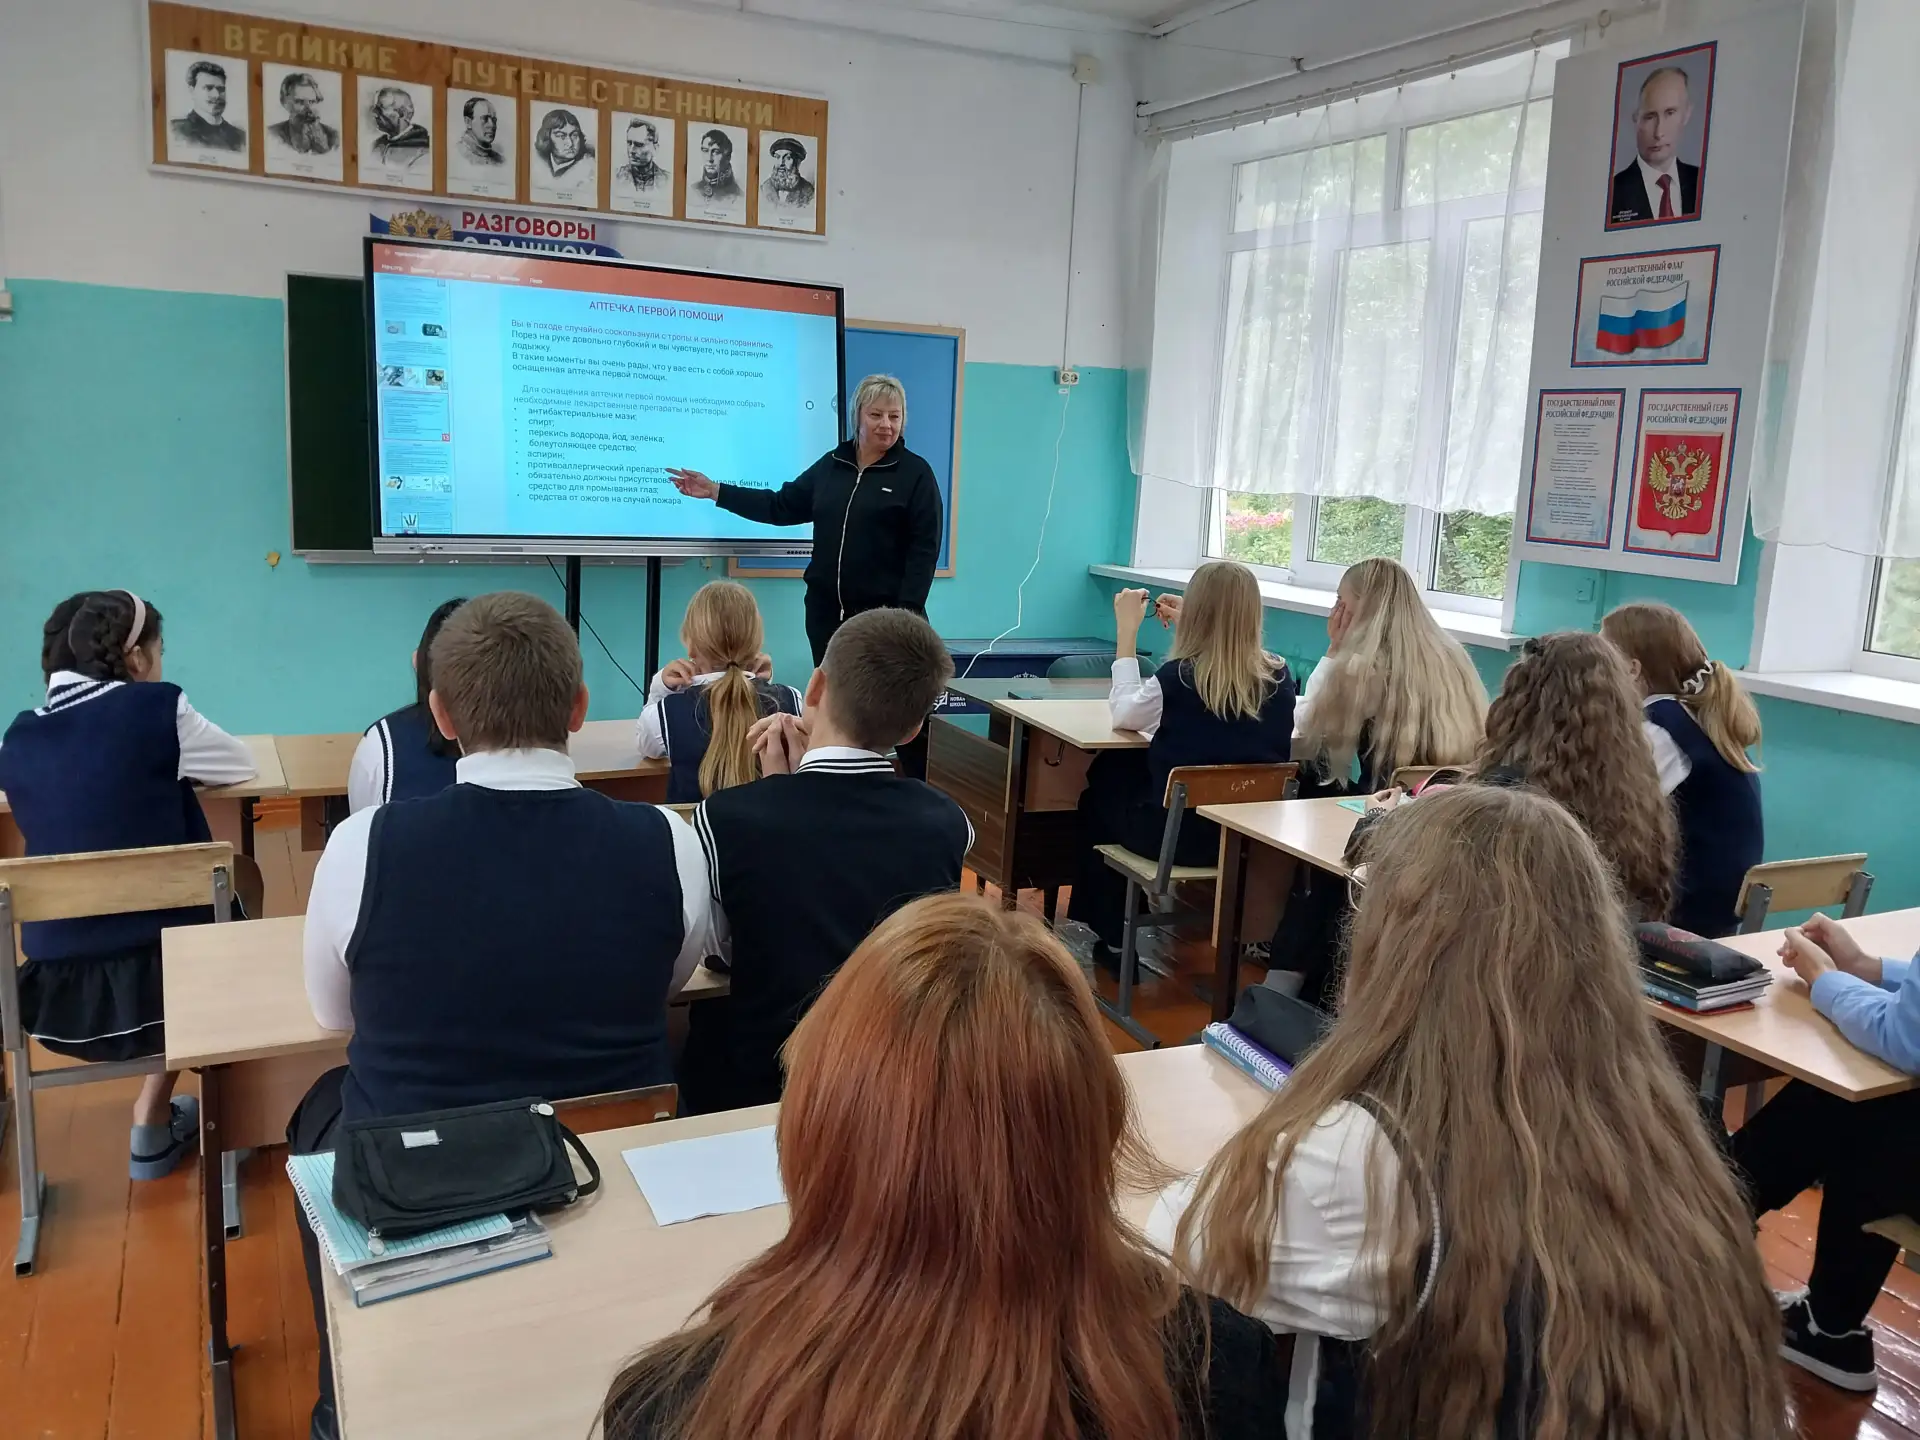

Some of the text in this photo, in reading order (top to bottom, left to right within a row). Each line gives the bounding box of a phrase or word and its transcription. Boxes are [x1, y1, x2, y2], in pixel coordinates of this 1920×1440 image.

[224, 24, 398, 74] ВЕЛИКИЕ
[452, 57, 773, 127] ПУТЕШЕСТВЕННИКИ
[462, 211, 596, 241] РАЗГОВОРЫ
[1608, 261, 1685, 275] ГОСУДАРСТВЕННЫЙ ФЛАГ
[1606, 273, 1684, 287] РОССИЙСКОЙ ФЕДЕРАЦИИ
[589, 301, 724, 322] АПТЕЧКА ПЕРВОЙ ПОМОЩИ
[511, 319, 524, 327] Вы
[533, 322, 563, 332] походе
[564, 324, 603, 335] случайно
[604, 328, 660, 340] соскользнули
[668, 333, 692, 343] тропы
[700, 337, 728, 345] сильно
[511, 330, 538, 341] Порез
[551, 334, 571, 344] руке
[572, 336, 612, 347] довольно
[613, 339, 650, 349] глубокий
[672, 344, 715, 356] чувствуете,
[730, 349, 769, 359] растянули
[512, 342, 552, 352] лодыжку.
[512, 363, 668, 382] оснащенная аптечка первой помощи.
[520, 353, 545, 361] такие
[546, 355, 586, 365] моменты
[602, 359, 626, 368] очень
[627, 361, 651, 371] рады,
[652, 363, 666, 371] что
[667, 364, 672, 372] у
[688, 366, 705, 374] есть
[713, 367, 734, 375] собой
[735, 370, 764, 379] хорошо
[522, 385, 766, 409] Для оснащения аптечки первой помощи необходимо собрать
[513, 396, 572, 407] необходимые
[574, 399, 638, 411] лекарственные
[639, 403, 683, 413] препараты
[1648, 402, 1729, 412] ГОСУДАРСТВЕННЫЙ ГЕРБ
[528, 407, 638, 421] антибактериальные мази;
[1545, 409, 1615, 420] РОССИЙСКОЙ ФЕДЕРАЦИИ
[1646, 413, 1728, 426] РОССИЙСКОЙ ФЕДЕРАЦИИ
[528, 418, 555, 428] спирт;
[528, 428, 569, 438] перекись
[570, 430, 611, 441] водорода,
[529, 439, 637, 453] болеутоляющее средство;
[527, 451, 566, 460] аспирин;
[527, 461, 624, 472] противоаллергический
[527, 471, 582, 481] обязательно
[583, 474, 617, 483] должны
[739, 478, 763, 487] бинты
[528, 482, 659, 495] средство для промывания глаз;
[528, 492, 567, 502] средства
[580, 495, 610, 503] ожогов
[623, 495, 651, 505] случай
